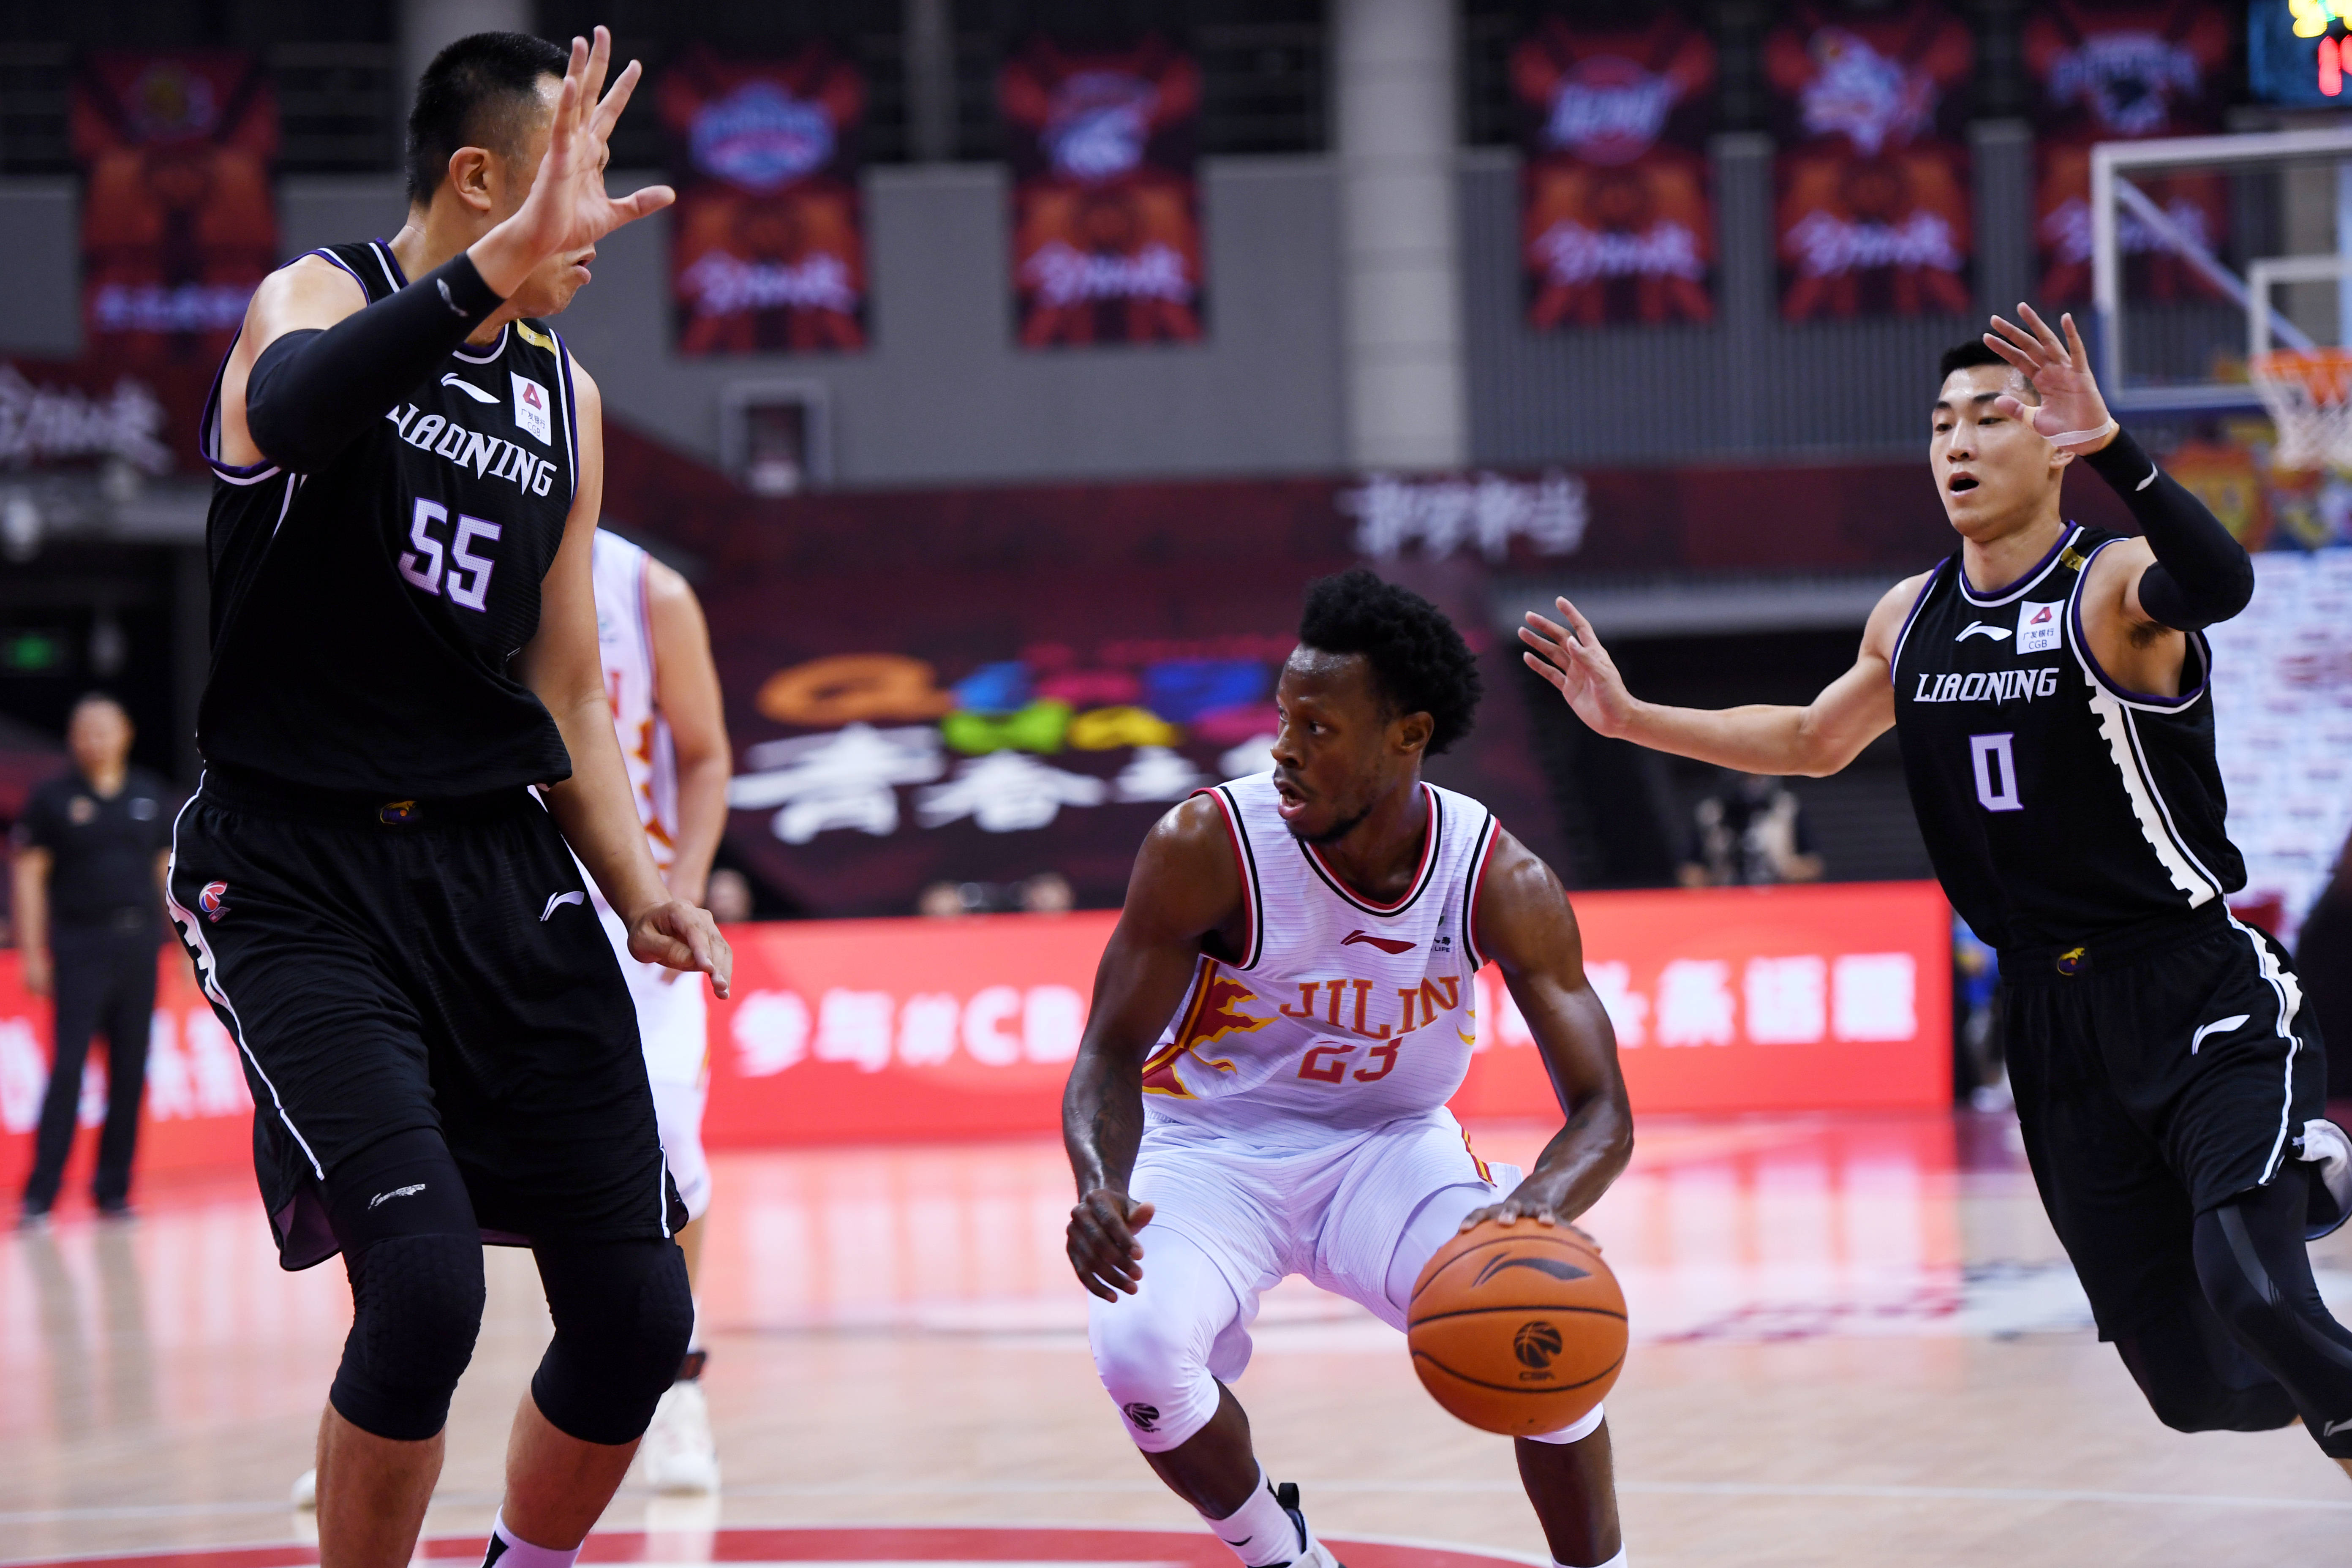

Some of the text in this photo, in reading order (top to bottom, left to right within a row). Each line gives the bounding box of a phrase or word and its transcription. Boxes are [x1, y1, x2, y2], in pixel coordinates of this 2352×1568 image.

[385, 403, 557, 497] IAONING
[527, 421, 541, 437] CGB
[397, 496, 503, 612] 55
[2028, 639, 2048, 650] CGB
[1913, 667, 2060, 706] LIAONING
[1968, 731, 2025, 813] 0
[1279, 975, 1461, 1040] JILIN
[1298, 1036, 1404, 1085] 23
